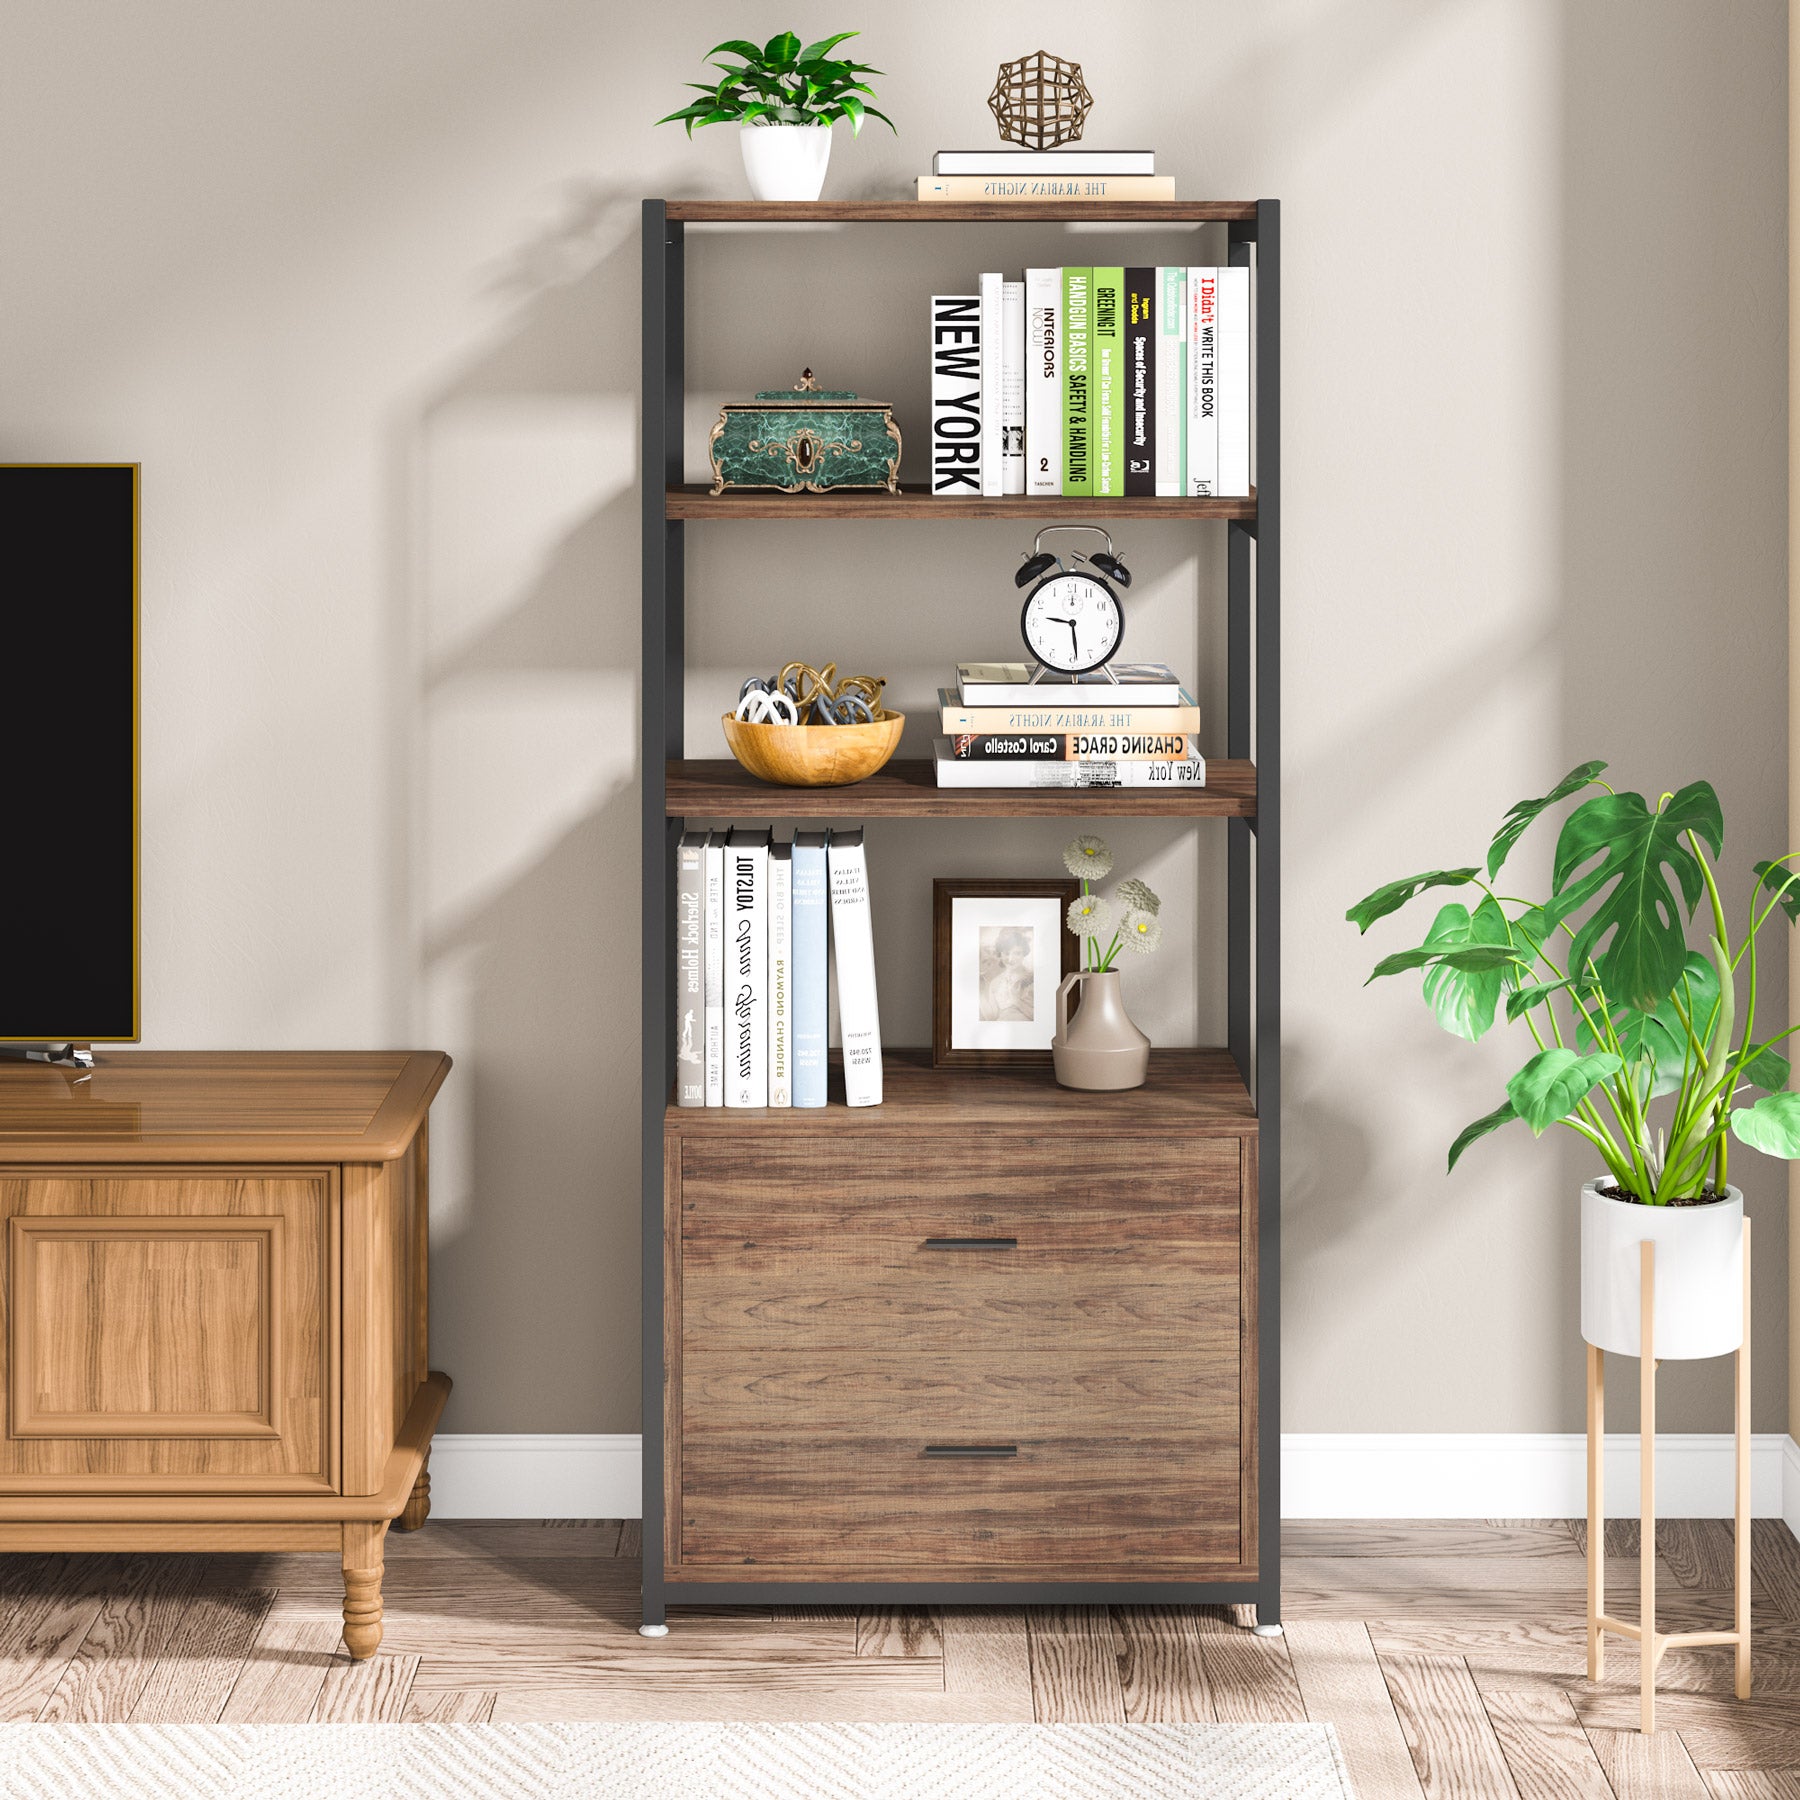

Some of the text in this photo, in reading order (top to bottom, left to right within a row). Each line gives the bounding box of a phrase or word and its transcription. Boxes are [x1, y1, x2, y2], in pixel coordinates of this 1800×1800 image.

[1097, 288, 1115, 338] GREENING IT
[1130, 293, 1138, 303] and
[1141, 297, 1150, 320] Ingram
[1201, 286, 1214, 324] Didn't
[1043, 307, 1055, 378] INTERIORS
[1201, 327, 1214, 359] WRITE
[1069, 276, 1087, 482] HANDGUN BASICS SAFETY & HANDLING
[1201, 361, 1214, 385] THIS
[934, 299, 981, 491] NEW YORK
[1132, 337, 1147, 446] Spaces of Security and Insecurity
[1201, 388, 1214, 418] BOOK
[1040, 458, 1048, 471] 2
